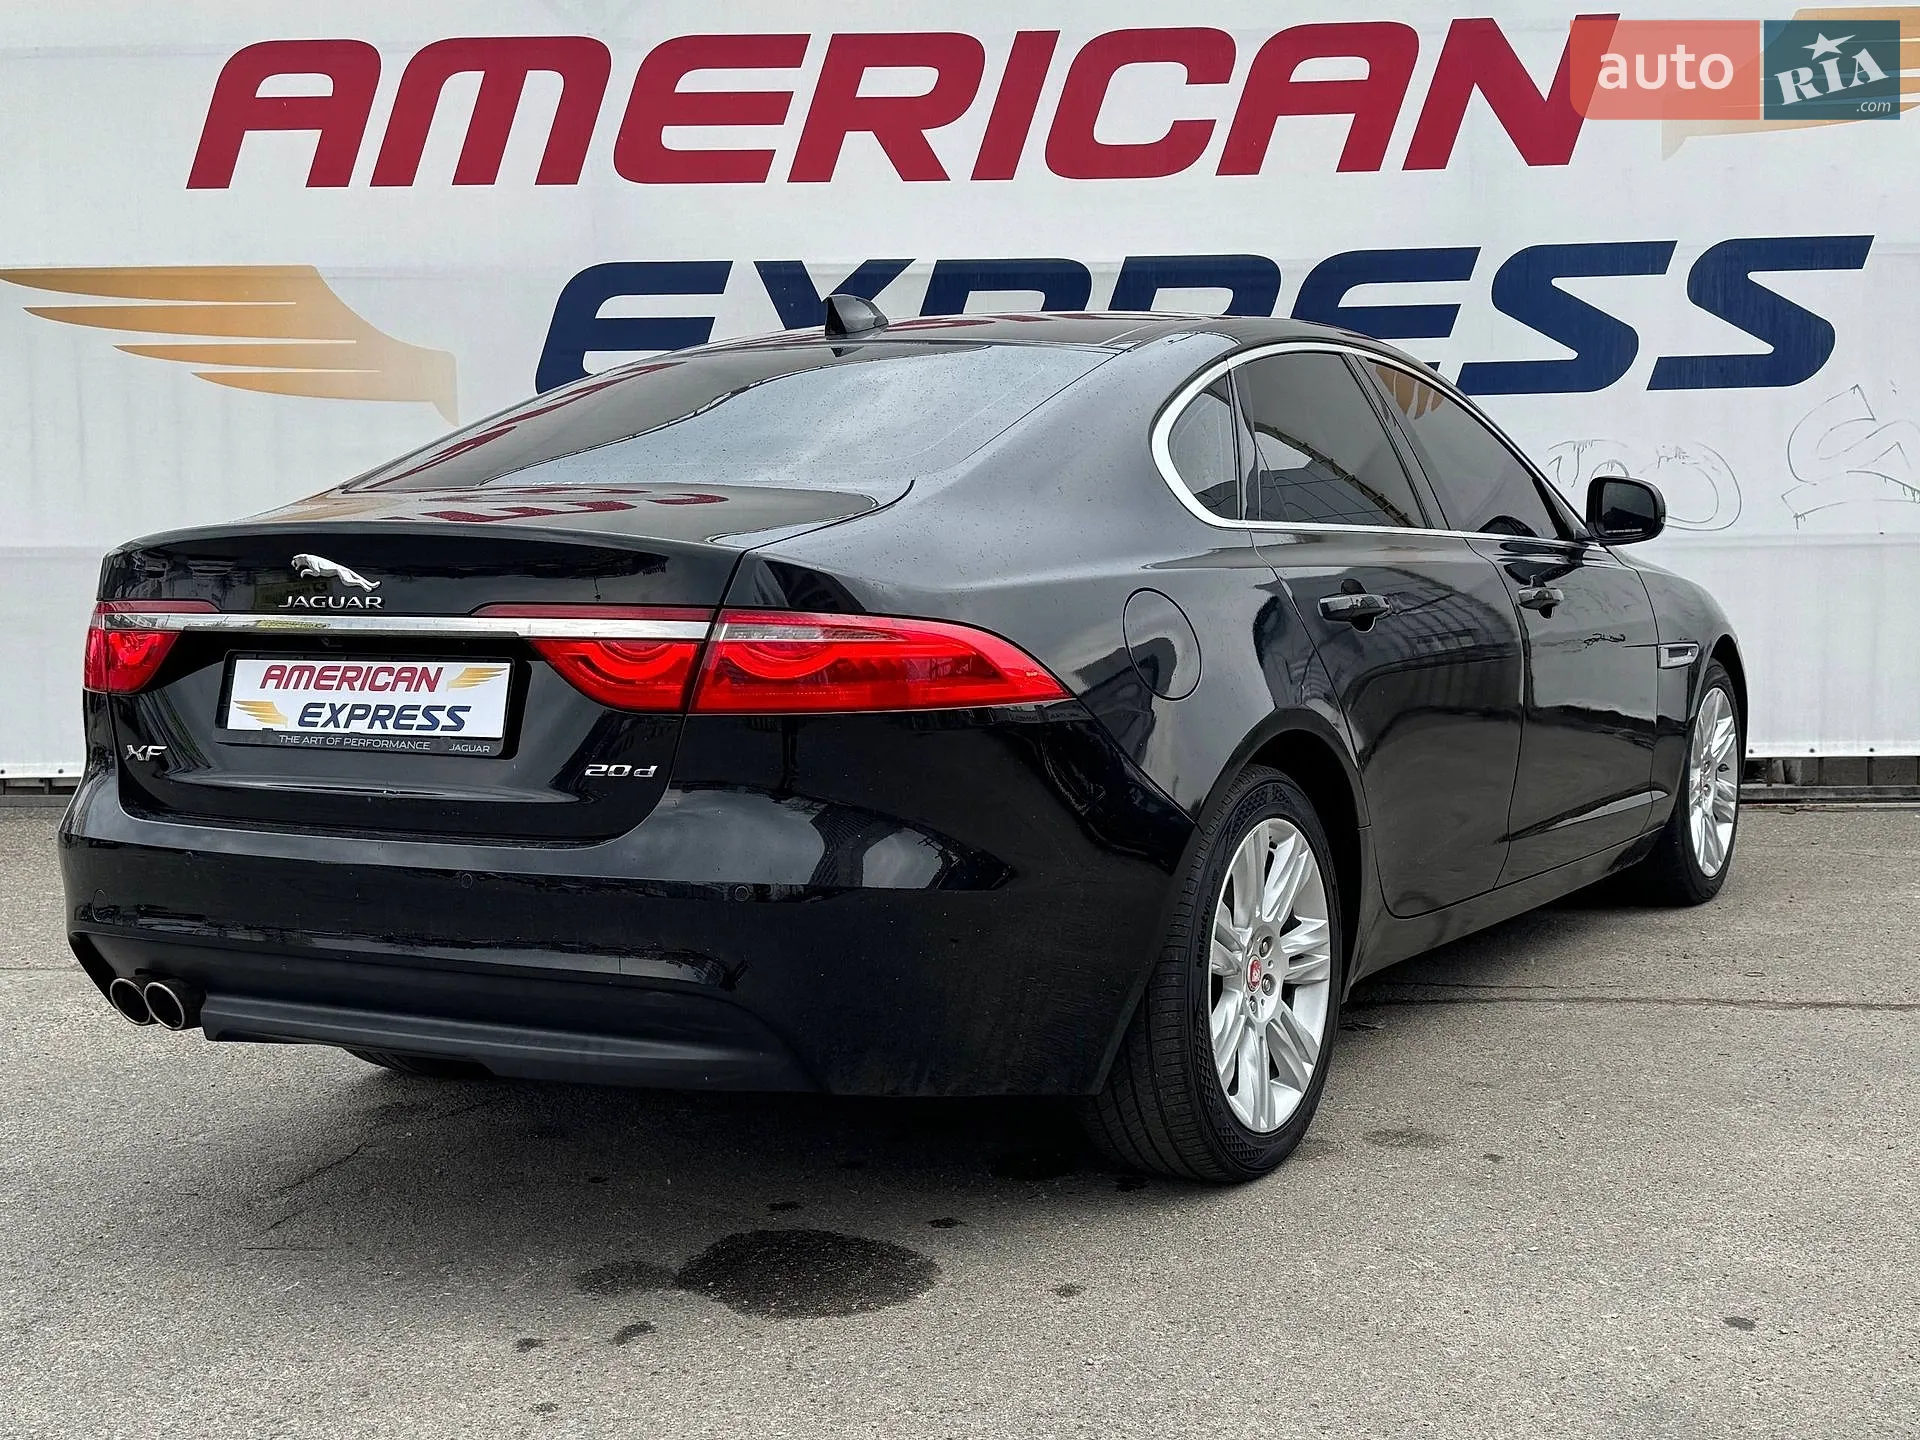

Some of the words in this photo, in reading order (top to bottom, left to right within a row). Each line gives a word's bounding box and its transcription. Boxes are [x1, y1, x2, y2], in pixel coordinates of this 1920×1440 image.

[188, 14, 1621, 188] AMERICAN
[278, 595, 384, 609] JAGUAR
[260, 664, 444, 693] AMERICAN
[297, 702, 472, 732] EXPRESS
[278, 734, 301, 744] THE
[301, 735, 326, 746] ART
[326, 736, 342, 746] OF
[343, 737, 431, 751] PERFORMANCE
[448, 743, 491, 753] JAGUAR
[124, 744, 168, 761] XF
